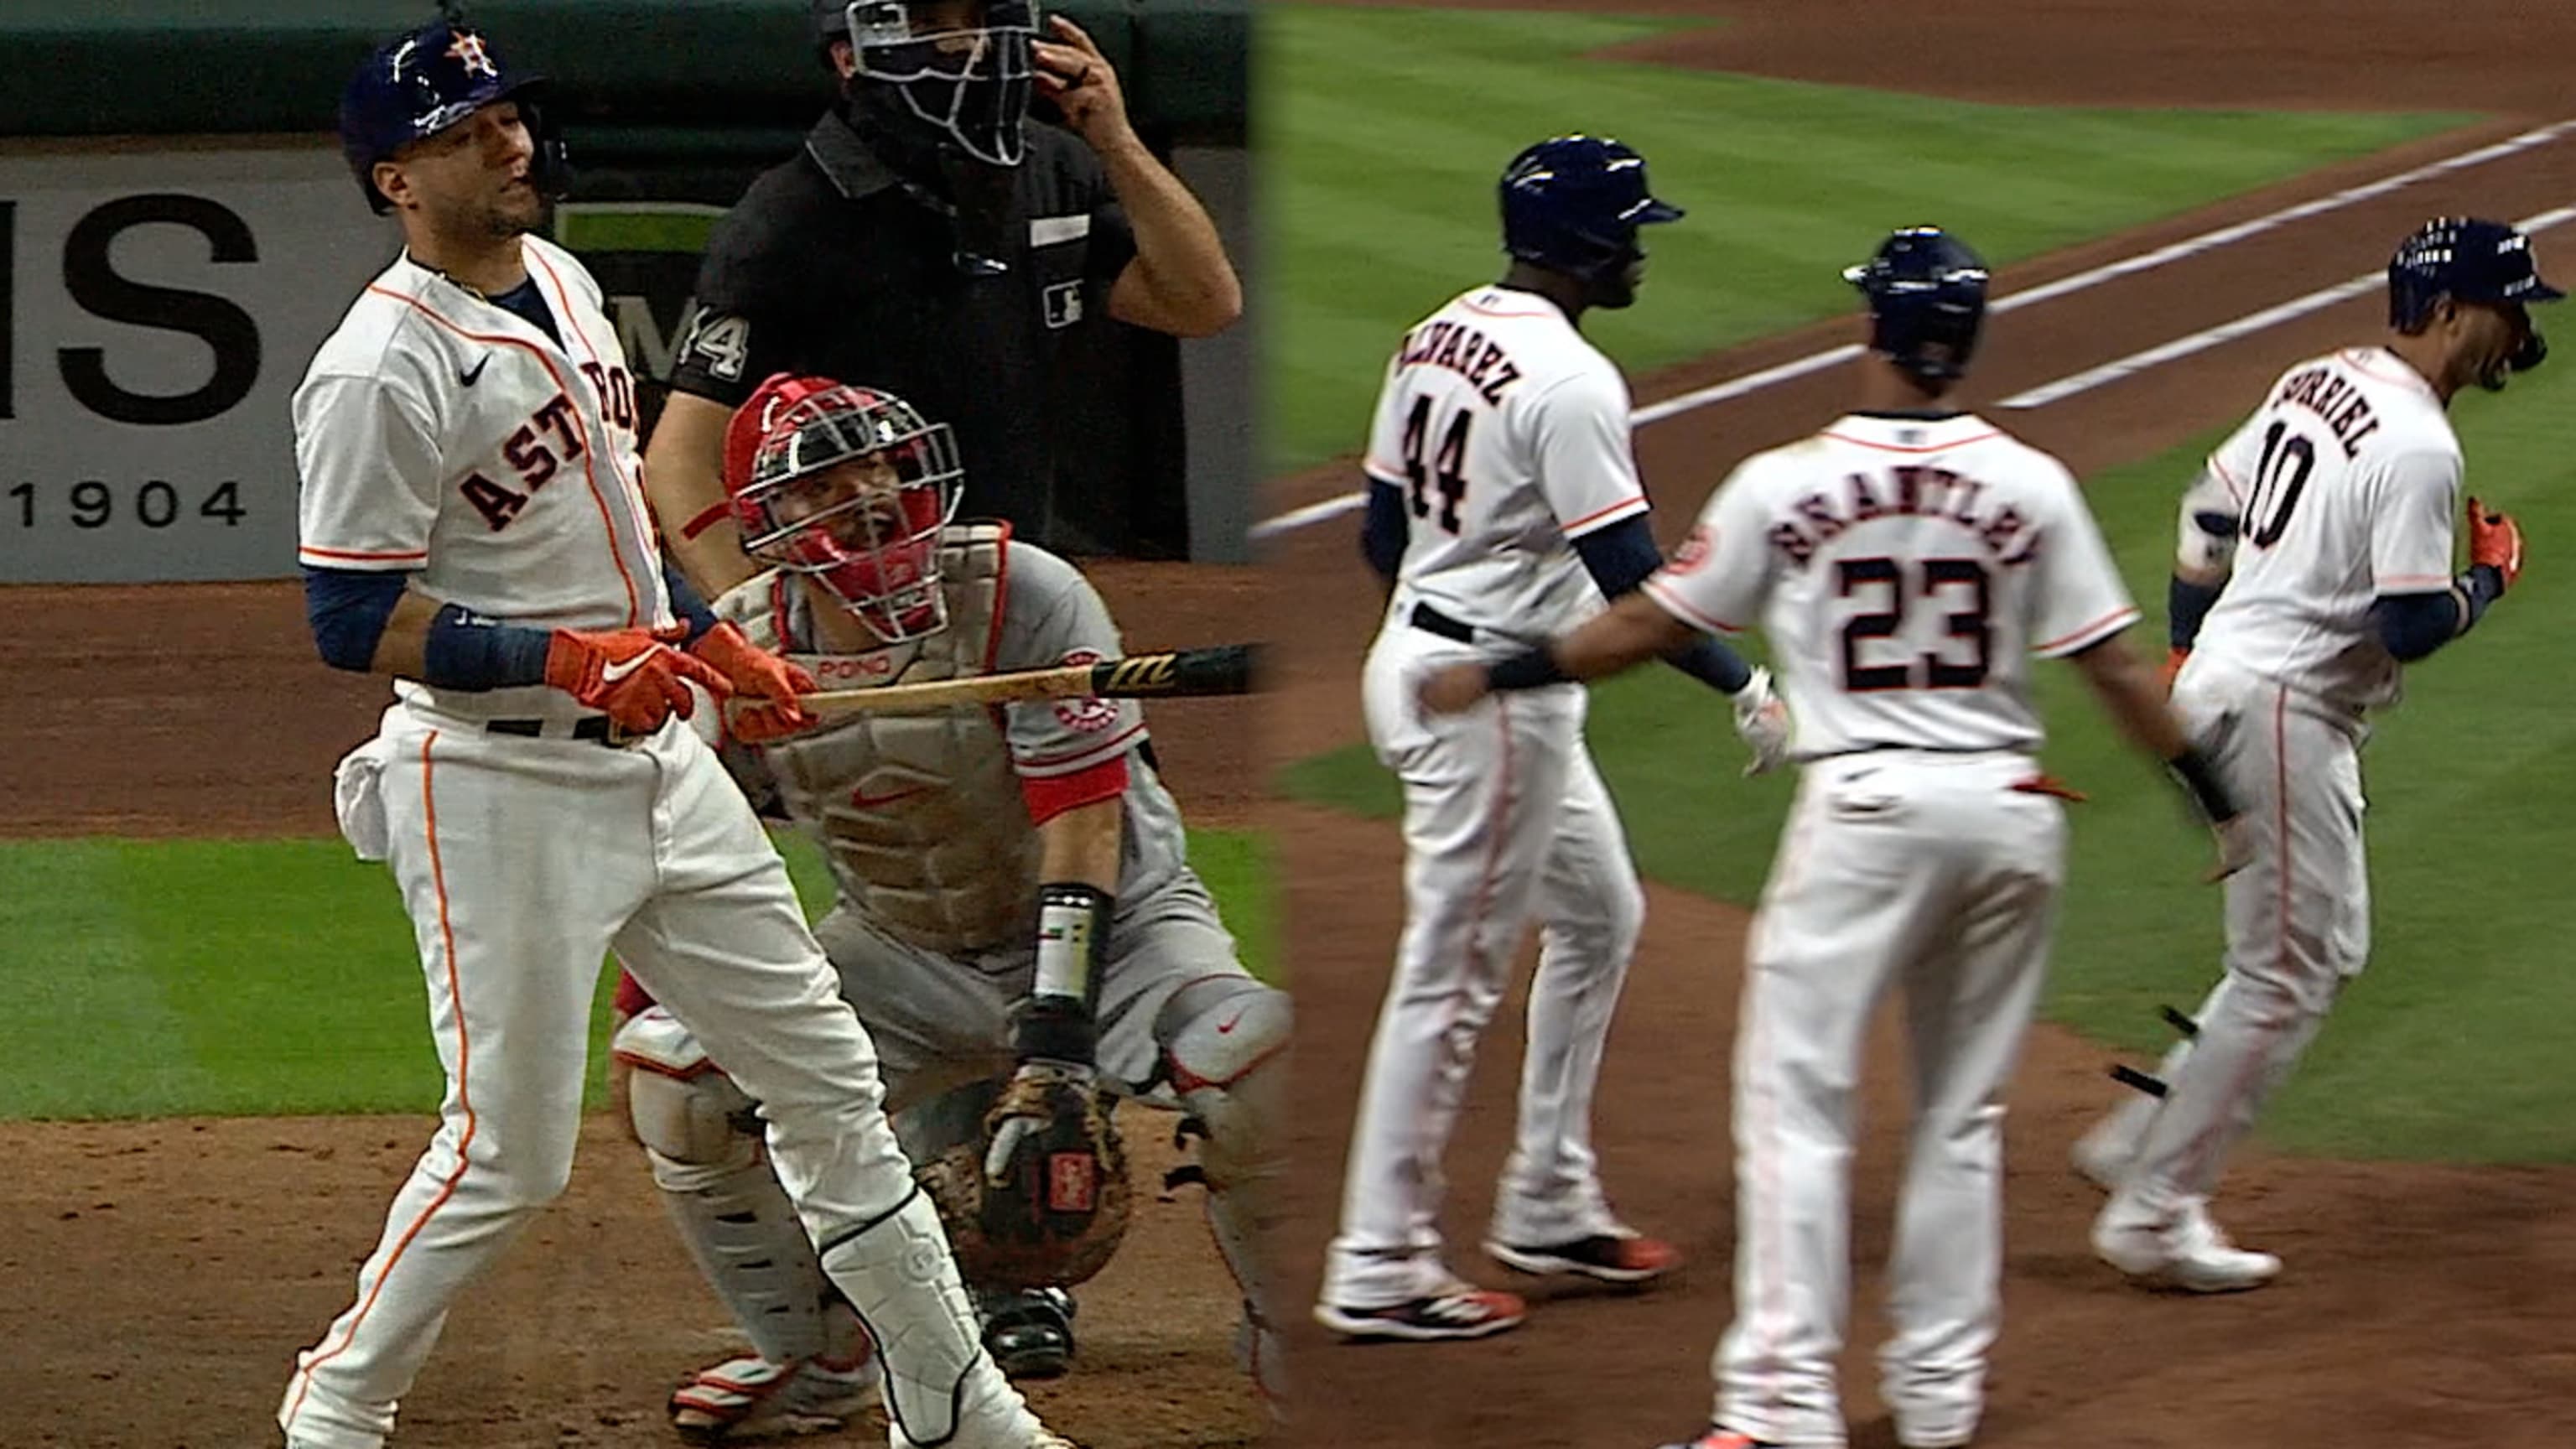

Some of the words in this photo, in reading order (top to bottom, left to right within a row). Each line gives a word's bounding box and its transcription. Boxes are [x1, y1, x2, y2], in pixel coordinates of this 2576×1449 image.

[0, 193, 262, 426] S
[1395, 321, 1522, 408] LVAREZ
[459, 361, 640, 532] ASTRO
[1403, 394, 1472, 535] 44
[2272, 366, 2381, 460] URRIEL
[8, 480, 247, 528] 1904
[1767, 465, 2044, 568] BRANTLEY
[2242, 421, 2316, 550] 10
[1835, 557, 1992, 691] 23
